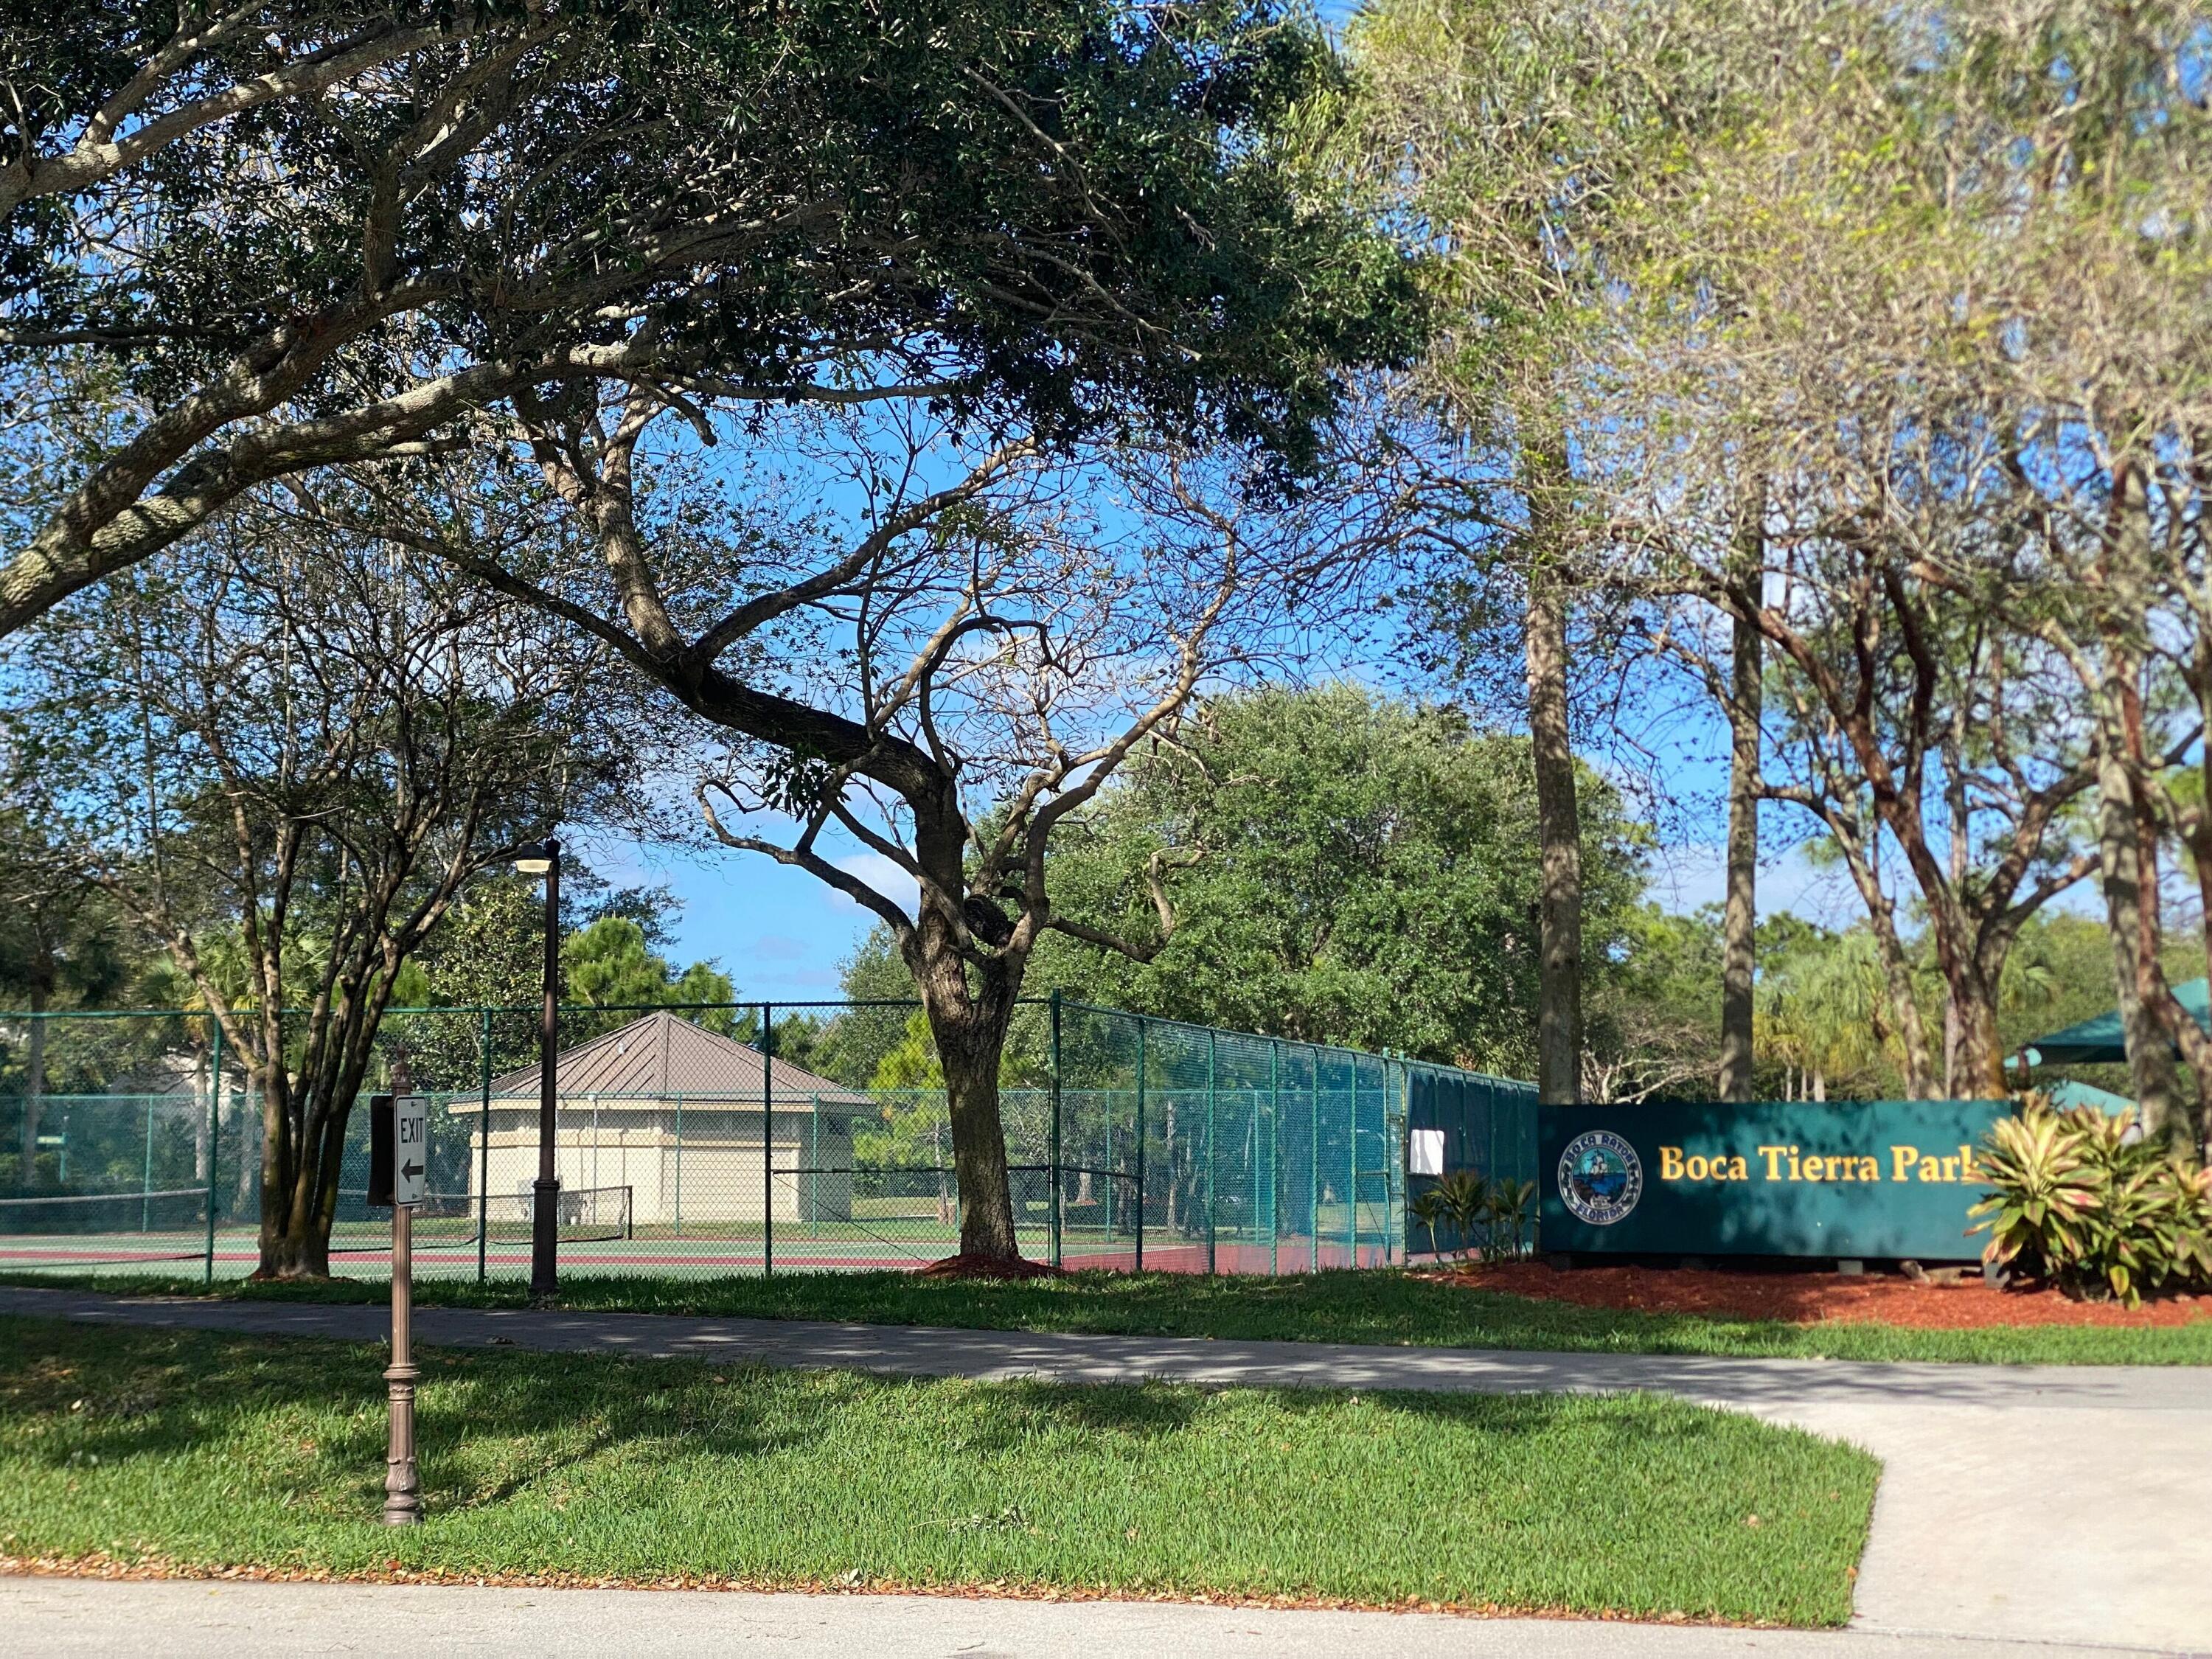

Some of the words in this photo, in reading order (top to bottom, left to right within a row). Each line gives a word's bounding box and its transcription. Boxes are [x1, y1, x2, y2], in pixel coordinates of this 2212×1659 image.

[400, 1117, 424, 1144] EXIT
[1565, 1135, 1597, 1163] BOCA
[1601, 1134, 1635, 1163] RATON
[1658, 1146, 1749, 1181] Boca
[1758, 1144, 1881, 1181] Tierra
[1576, 1203, 1624, 1221] FLORIDA
